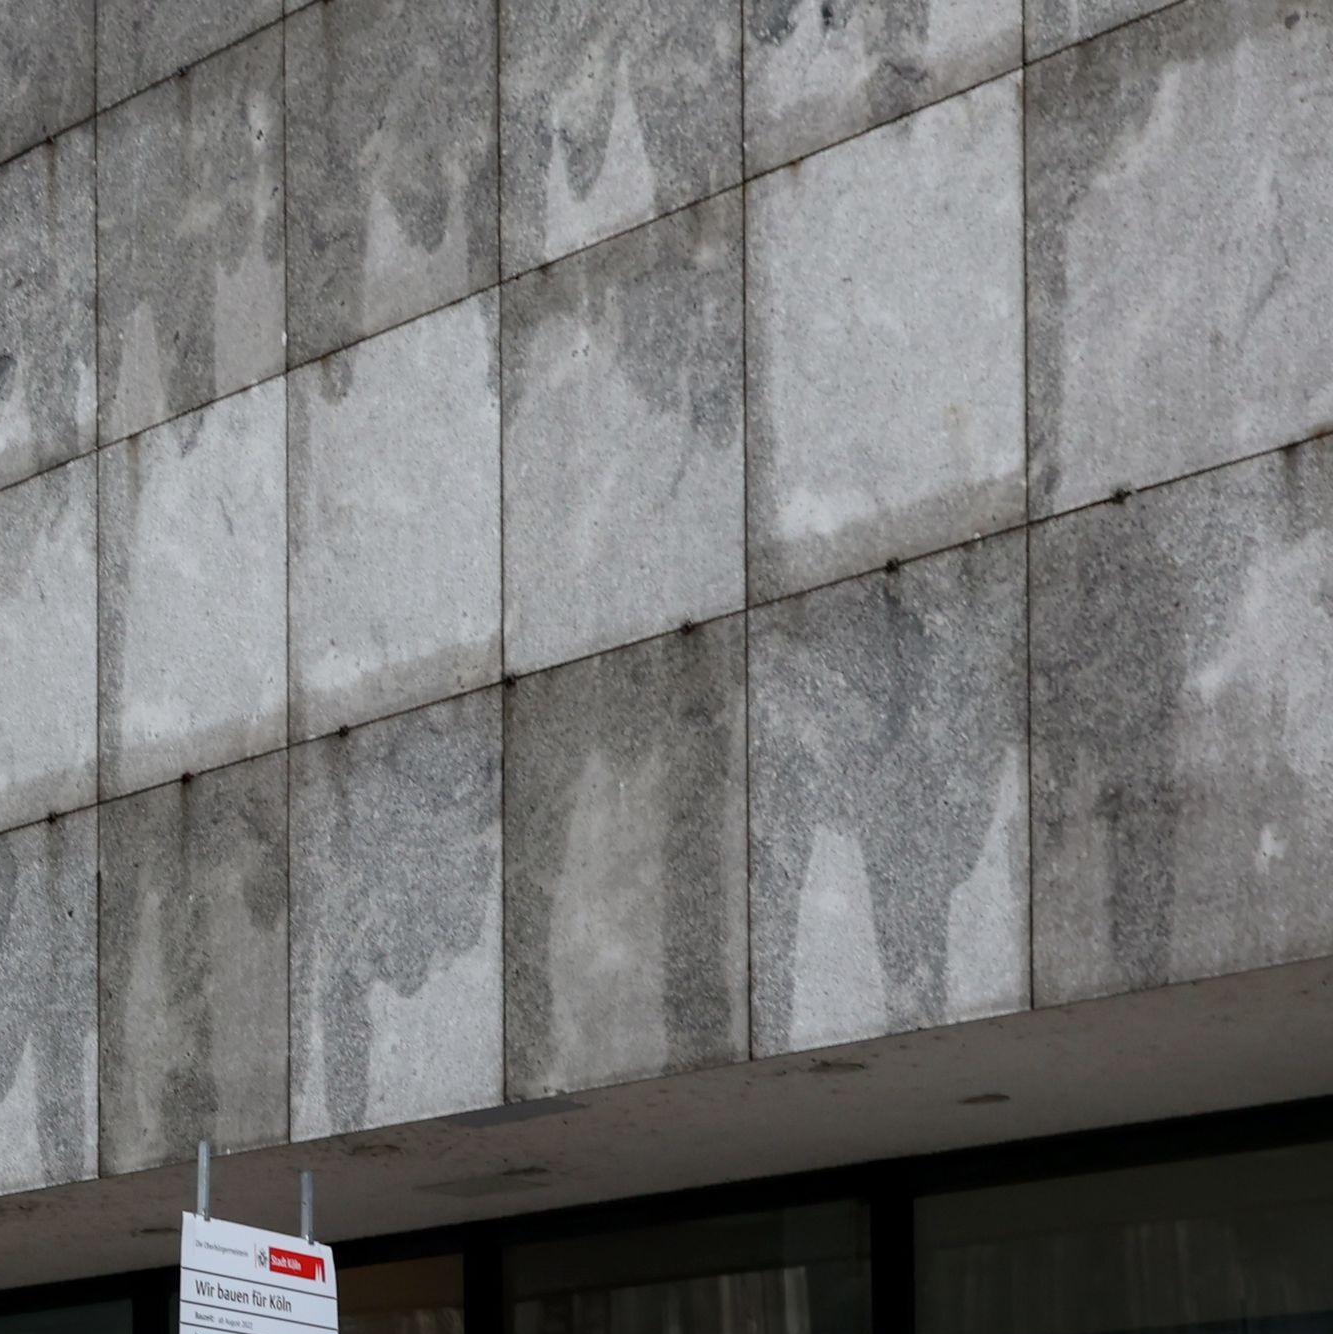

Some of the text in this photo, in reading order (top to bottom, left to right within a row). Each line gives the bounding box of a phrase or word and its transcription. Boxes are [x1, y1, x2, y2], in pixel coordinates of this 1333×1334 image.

[271, 1254, 302, 1271] Stadt Köln
[195, 1279, 292, 1312] Wir bauen für Köln
